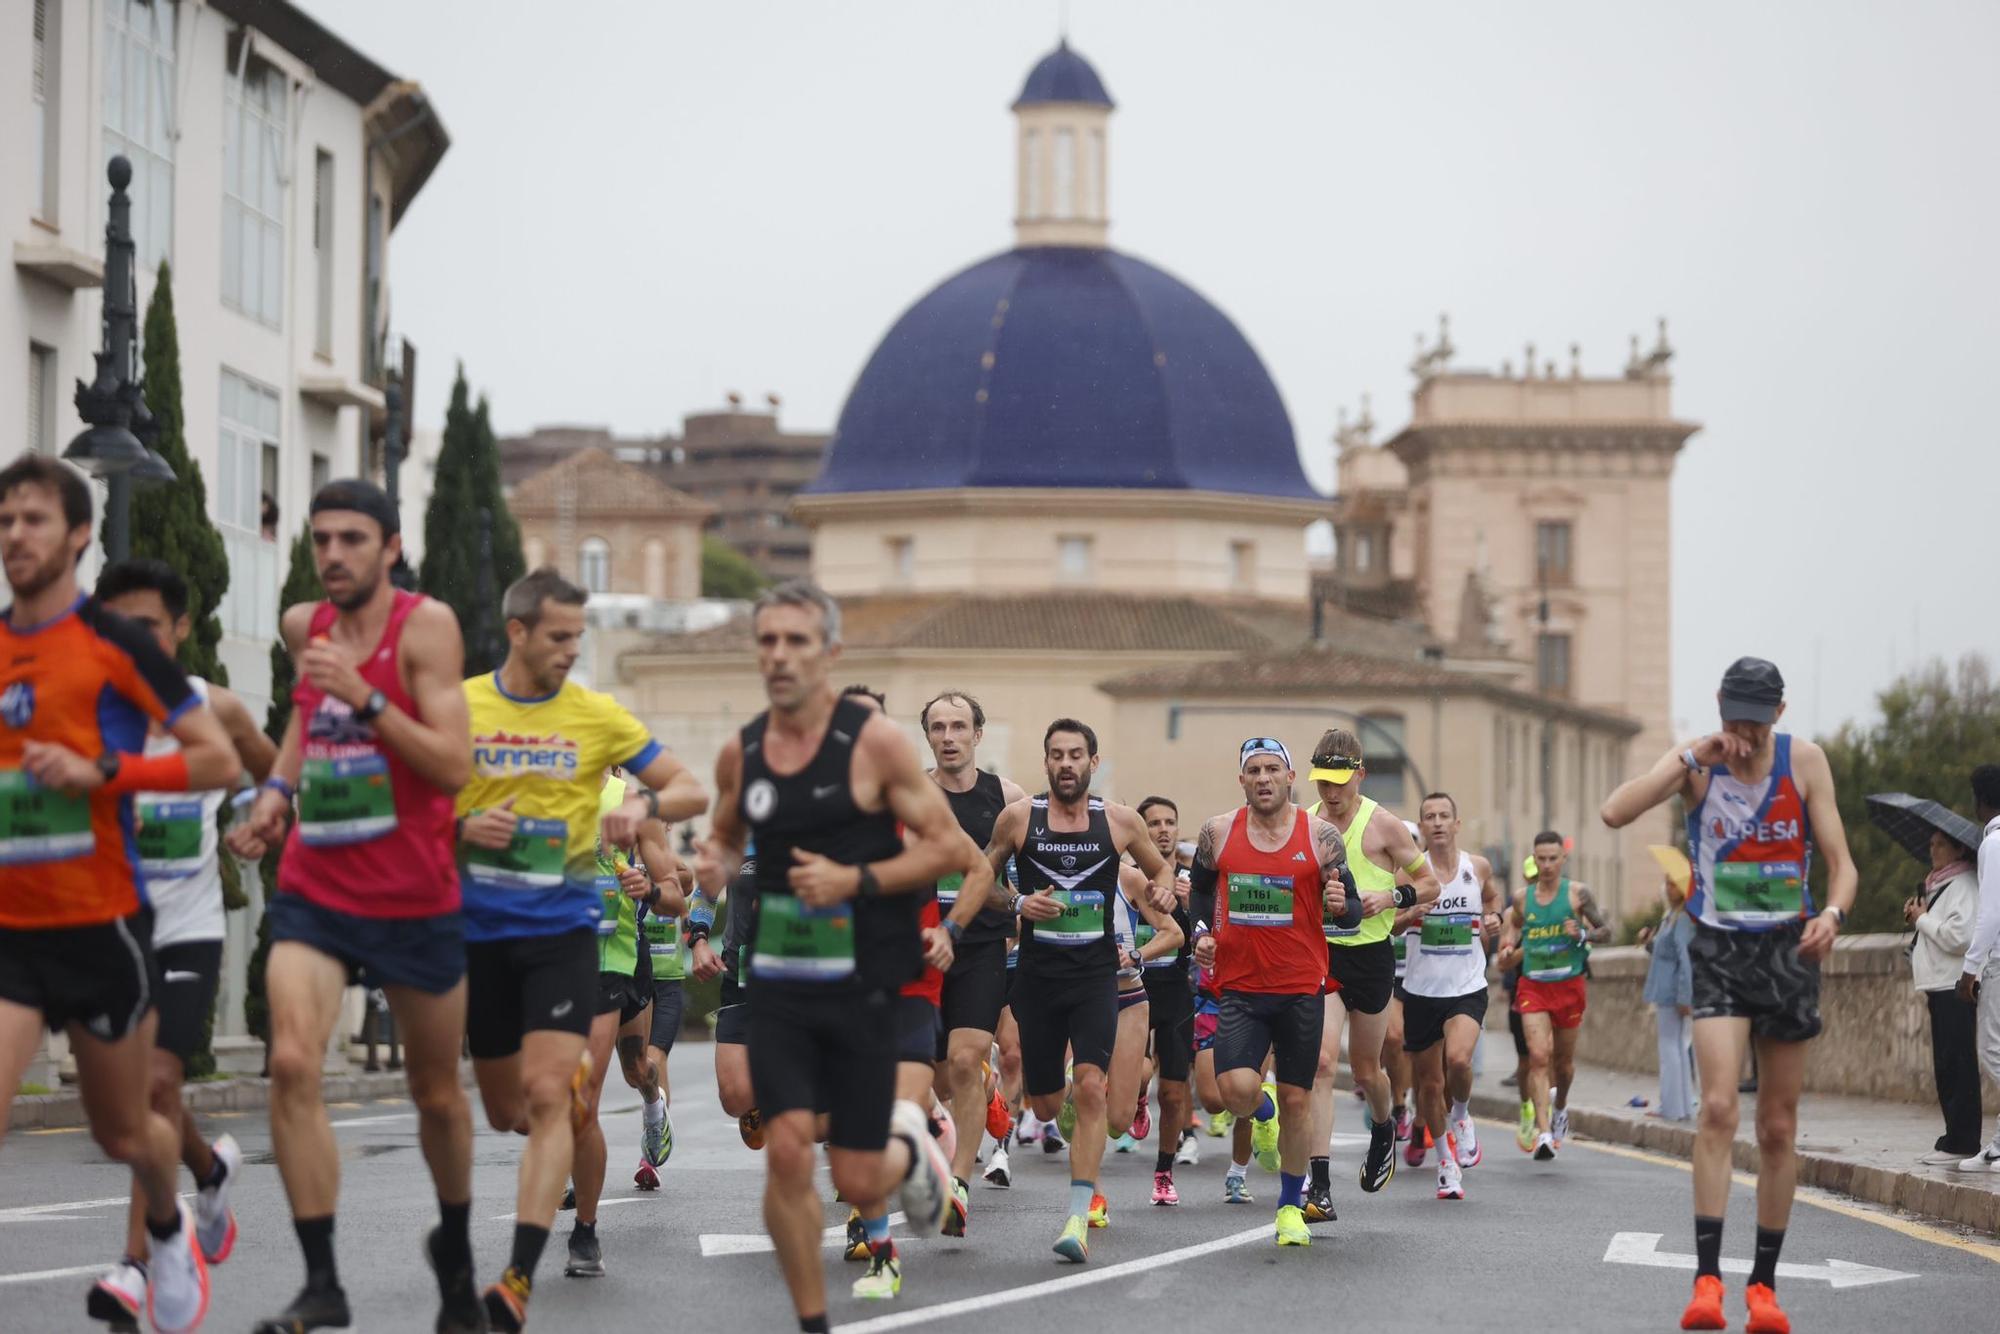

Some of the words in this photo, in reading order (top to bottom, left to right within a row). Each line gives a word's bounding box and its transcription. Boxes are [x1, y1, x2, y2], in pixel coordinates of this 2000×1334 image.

[474, 748, 577, 768] runners
[1037, 842, 1100, 852] BORDEAUX
[1247, 889, 1271, 900] 1161
[1240, 903, 1266, 912] PEDRO
[1268, 903, 1280, 912] PG
